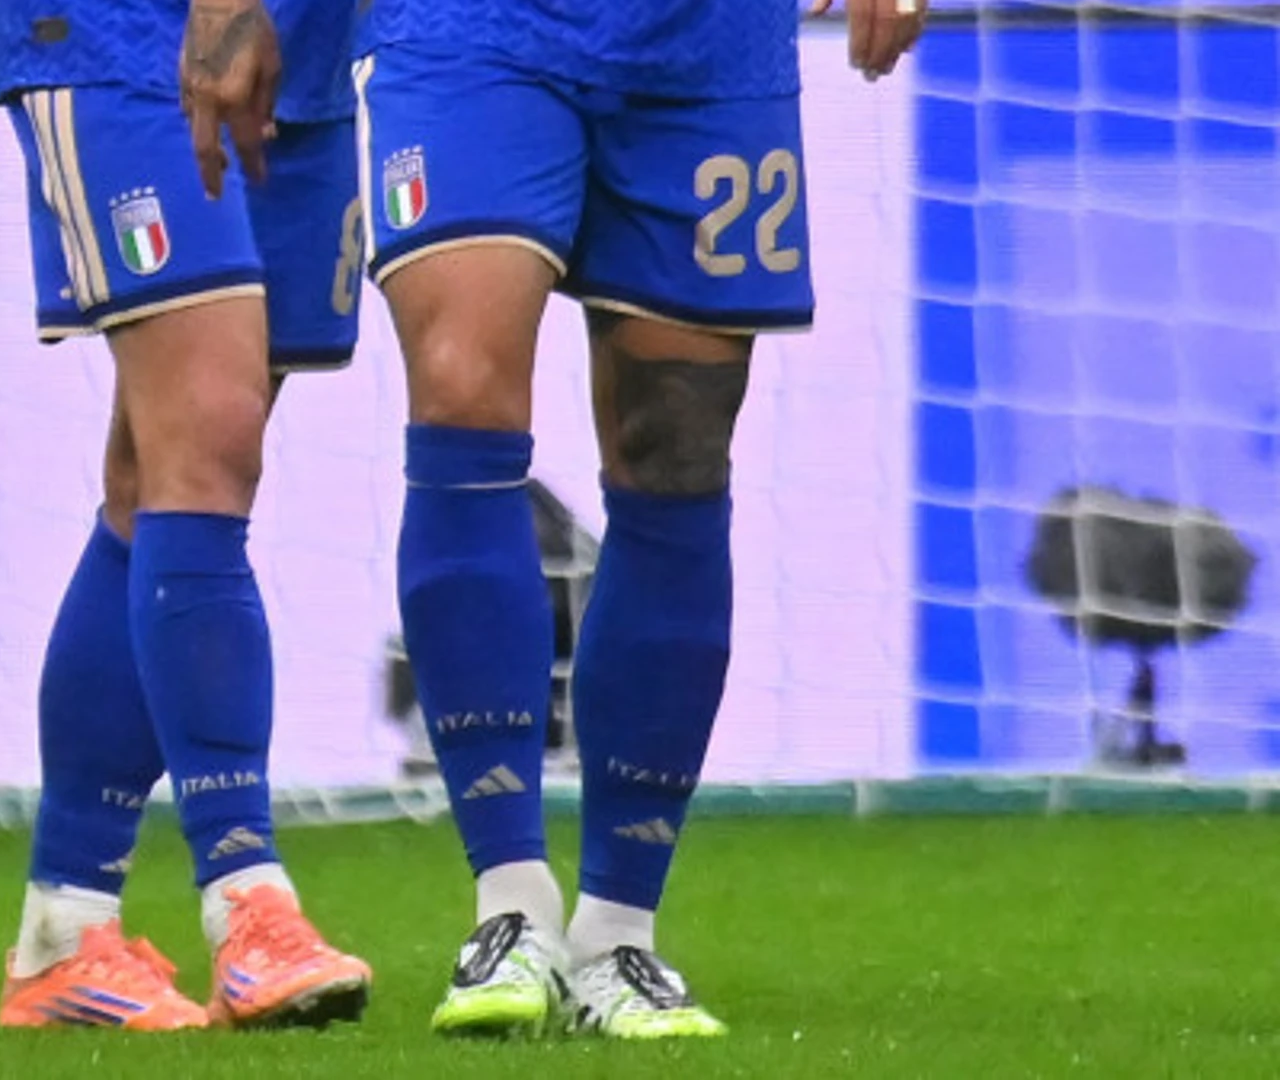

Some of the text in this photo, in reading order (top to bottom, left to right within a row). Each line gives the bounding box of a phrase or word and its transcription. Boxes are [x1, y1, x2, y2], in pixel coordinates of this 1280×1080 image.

[693, 148, 800, 277] 22
[436, 710, 533, 733] ITALIA
[181, 771, 260, 797] ITALIA
